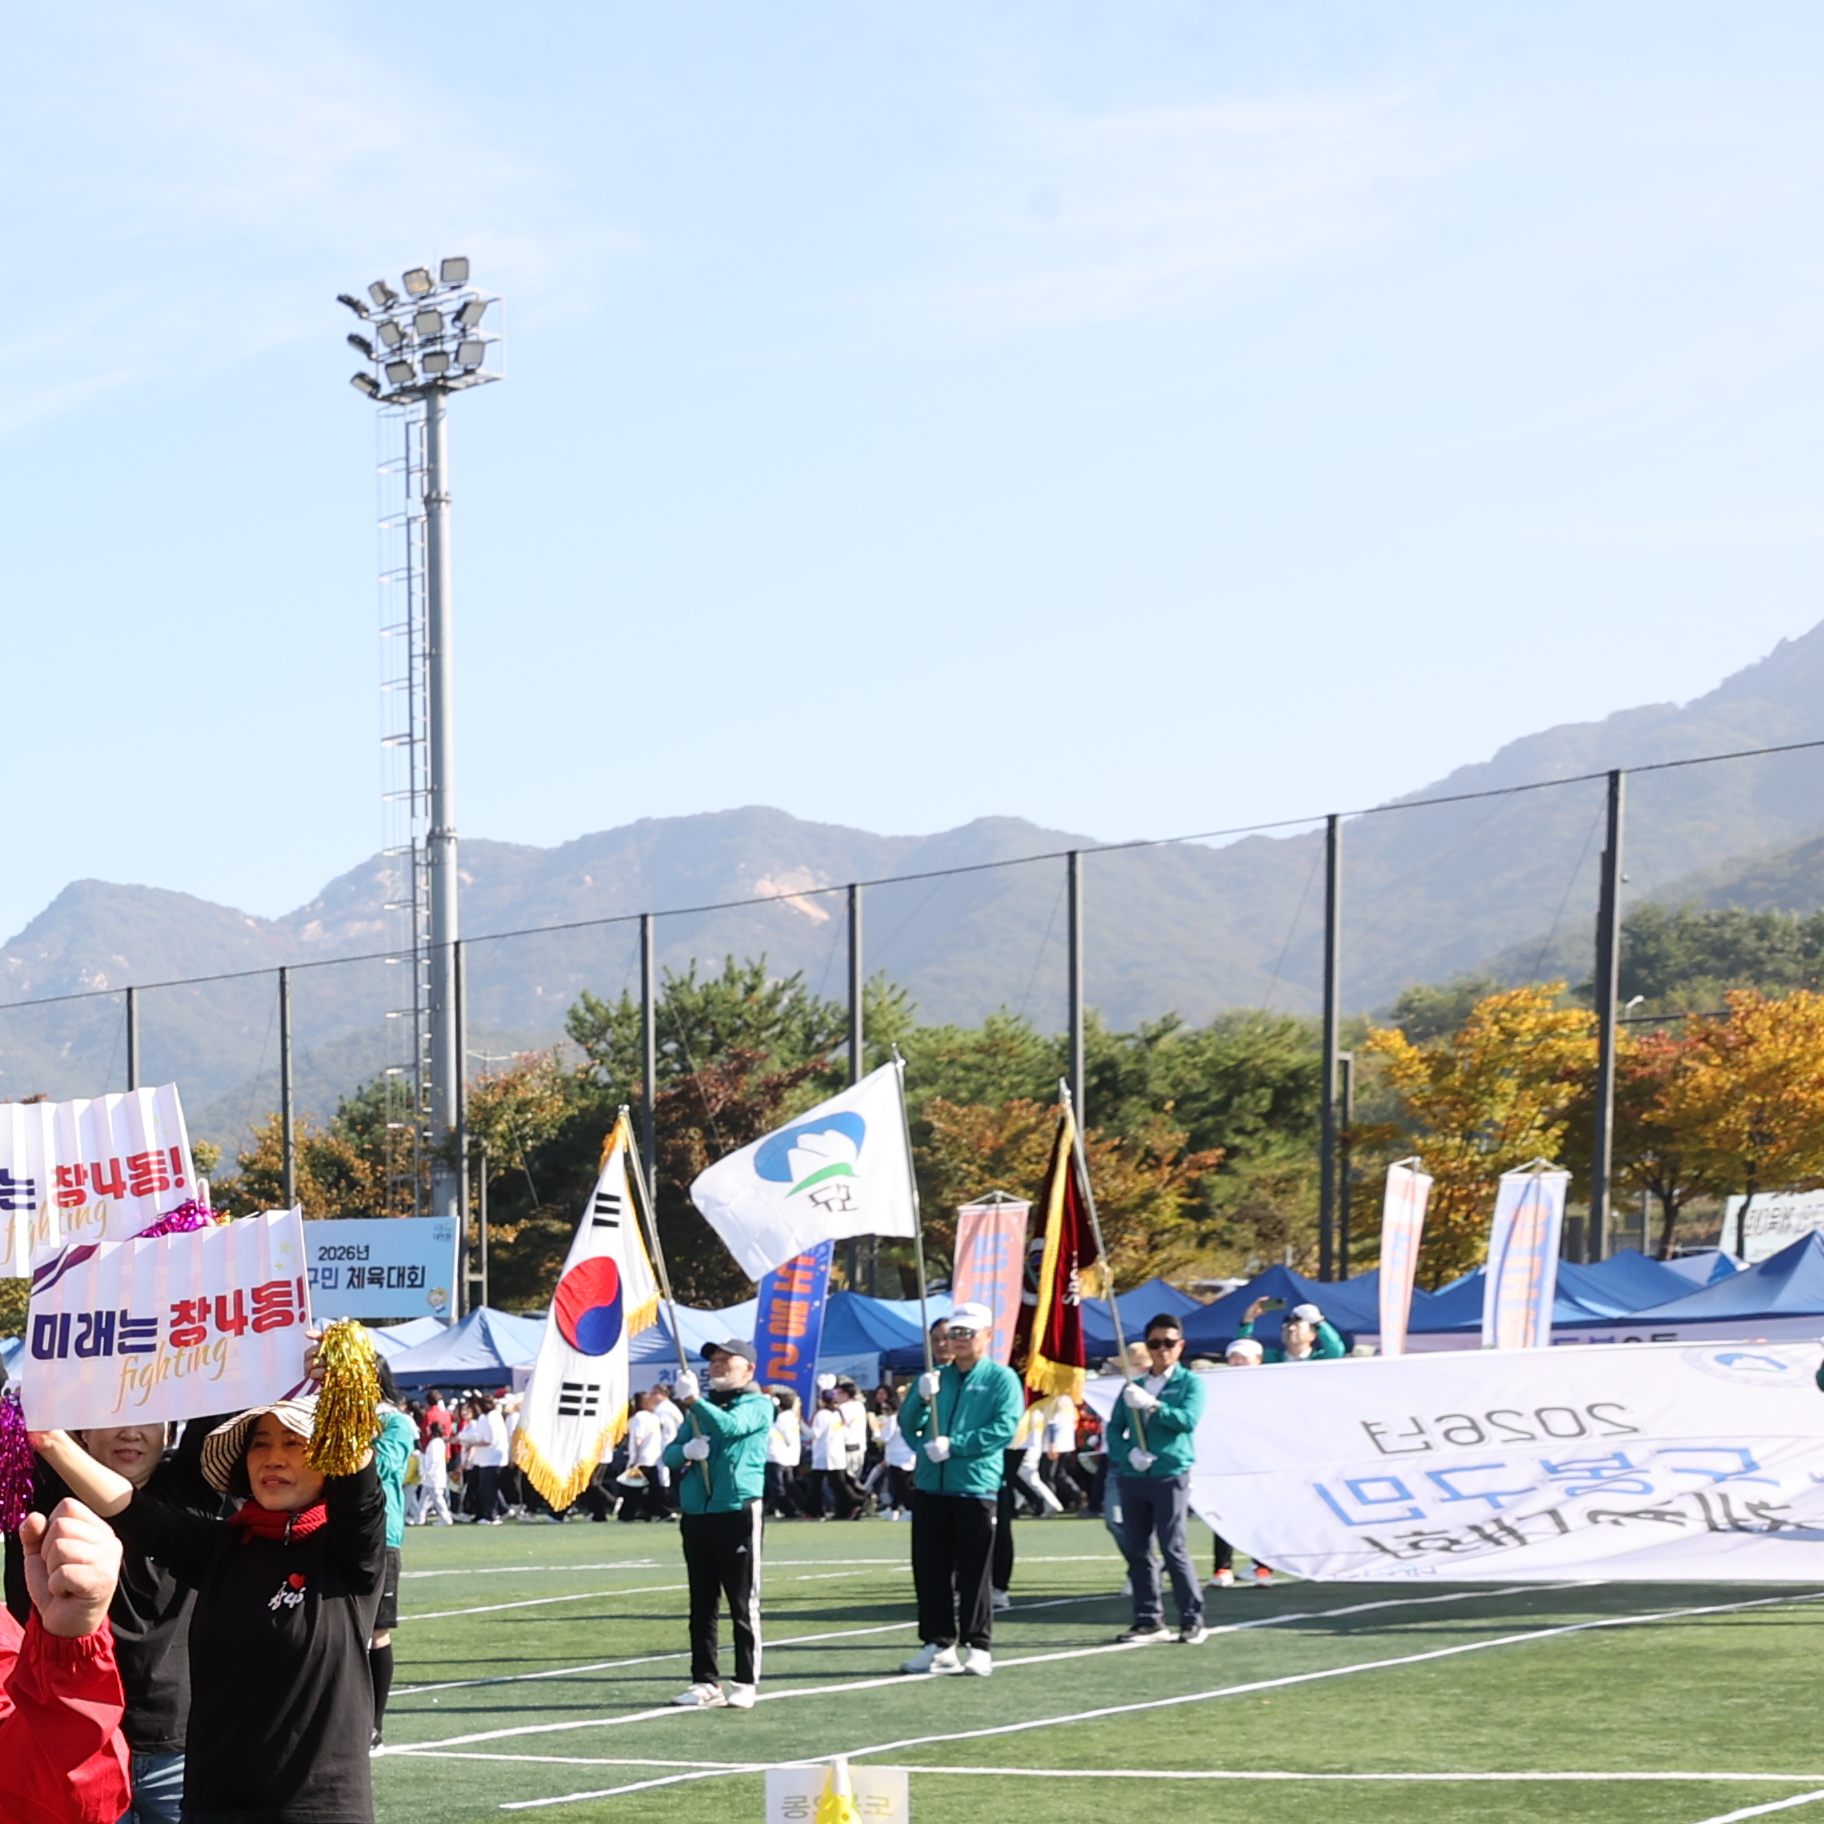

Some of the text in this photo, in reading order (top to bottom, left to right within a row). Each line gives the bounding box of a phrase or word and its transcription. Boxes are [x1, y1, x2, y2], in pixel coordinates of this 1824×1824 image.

[50, 1146, 186, 1208] 창4동!
[307, 1264, 426, 1290] 구민 체육대회
[318, 1244, 370, 1261] 2026년
[31, 1311, 158, 1360] 미래는
[168, 1275, 307, 1348] 창4동!
[112, 1335, 231, 1413] fighting
